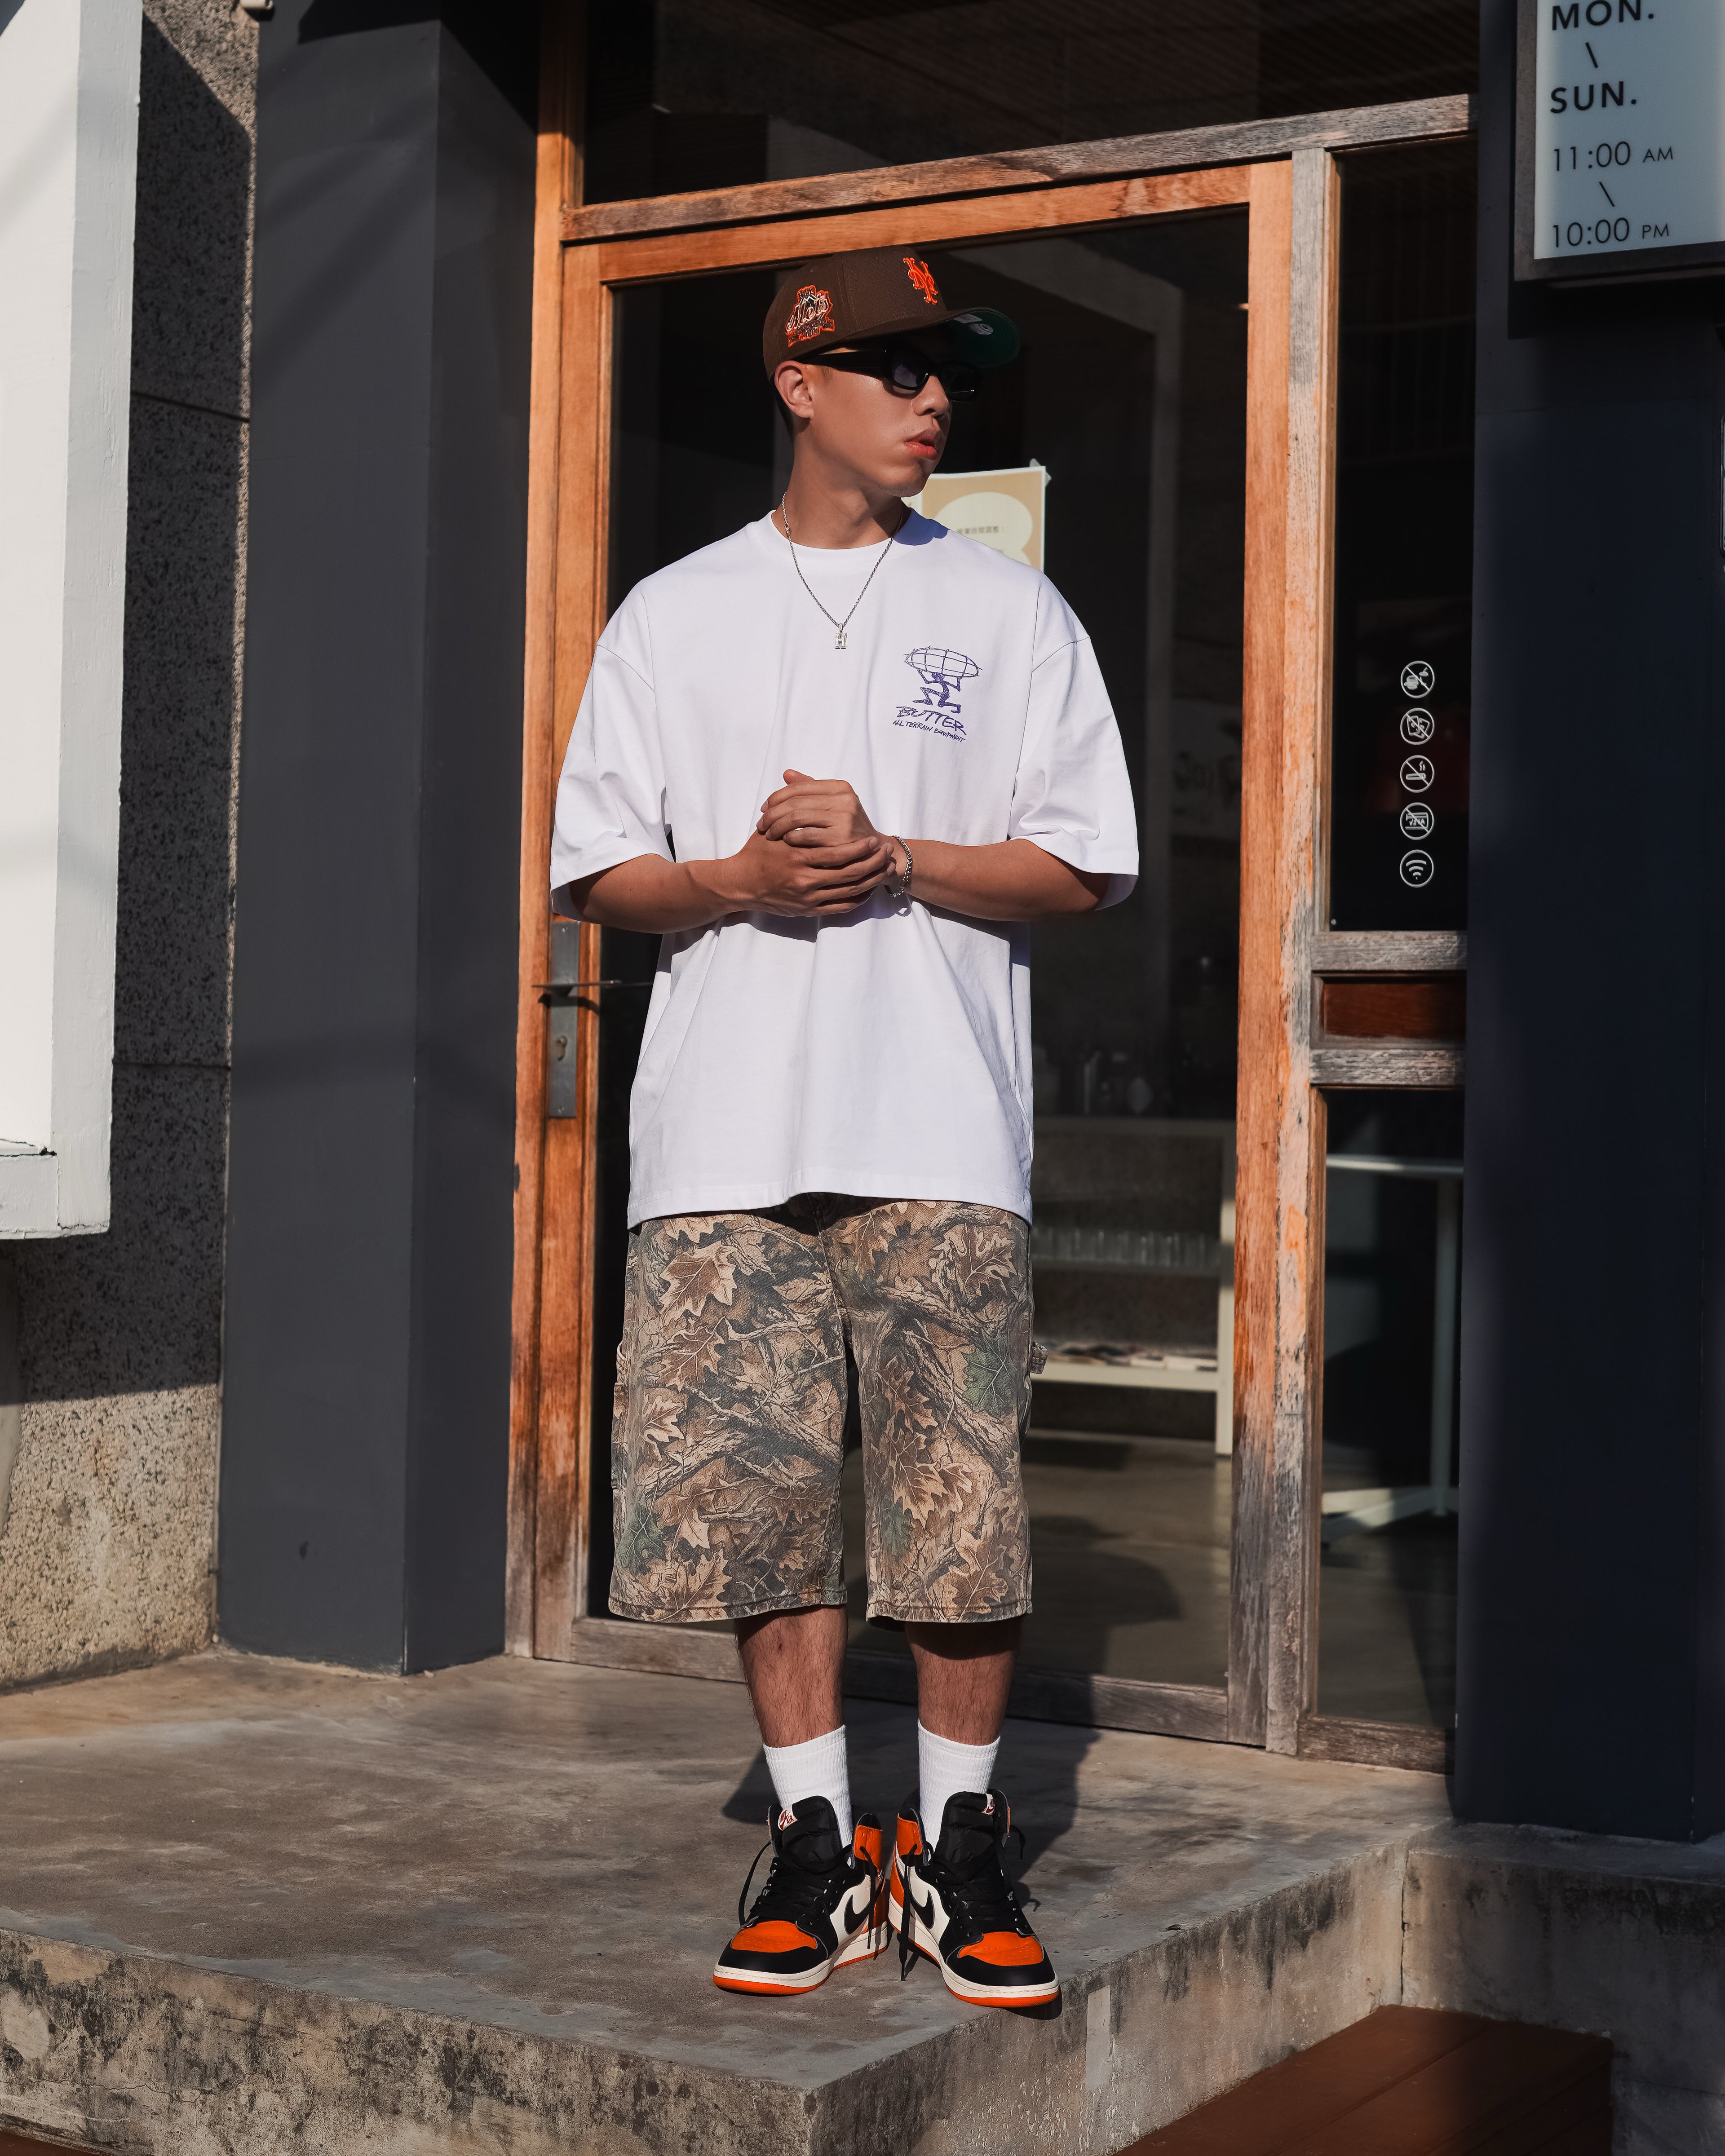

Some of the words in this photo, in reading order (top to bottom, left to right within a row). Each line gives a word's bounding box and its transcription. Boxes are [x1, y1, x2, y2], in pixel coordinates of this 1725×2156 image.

[1552, 0, 1654, 31] MON.
[1550, 80, 1637, 114] SUN.
[1553, 141, 1631, 172] 11:00
[1642, 146, 1674, 163] AM
[1552, 217, 1630, 248] 10:00
[1641, 223, 1670, 239] PM
[786, 292, 829, 333] Mets
[895, 706, 967, 736] BUTTER
[905, 721, 933, 732] TERRAIN
[933, 728, 966, 743] EQUIPMENT
